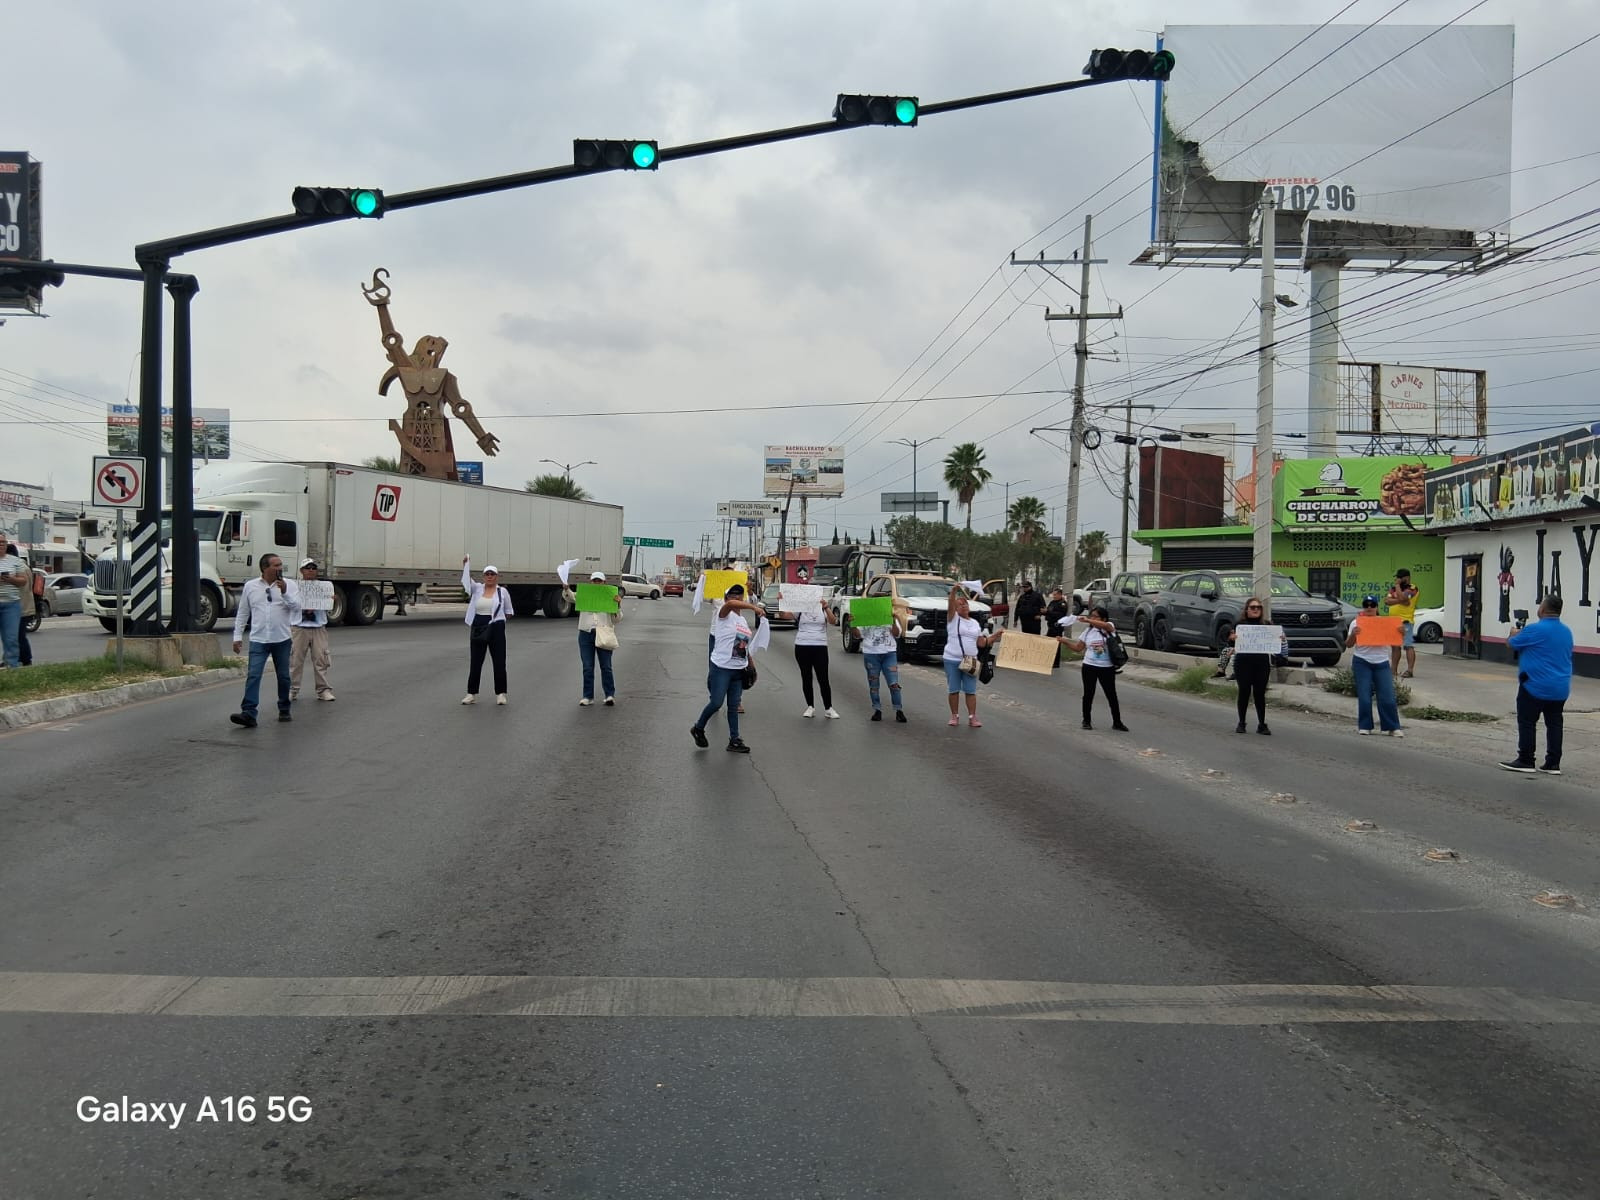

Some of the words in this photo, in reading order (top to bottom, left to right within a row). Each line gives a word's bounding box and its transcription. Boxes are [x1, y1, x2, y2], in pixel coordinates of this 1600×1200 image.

[1291, 185, 1320, 210] 02
[1326, 185, 1355, 211] 96
[1391, 374, 1424, 390] CARNES
[380, 494, 394, 512] TIP
[1287, 501, 1379, 511] CHICHARRON
[1297, 513, 1316, 521] DE
[1320, 513, 1367, 521] CERDO
[1303, 560, 1356, 568] CHAVARRIA
